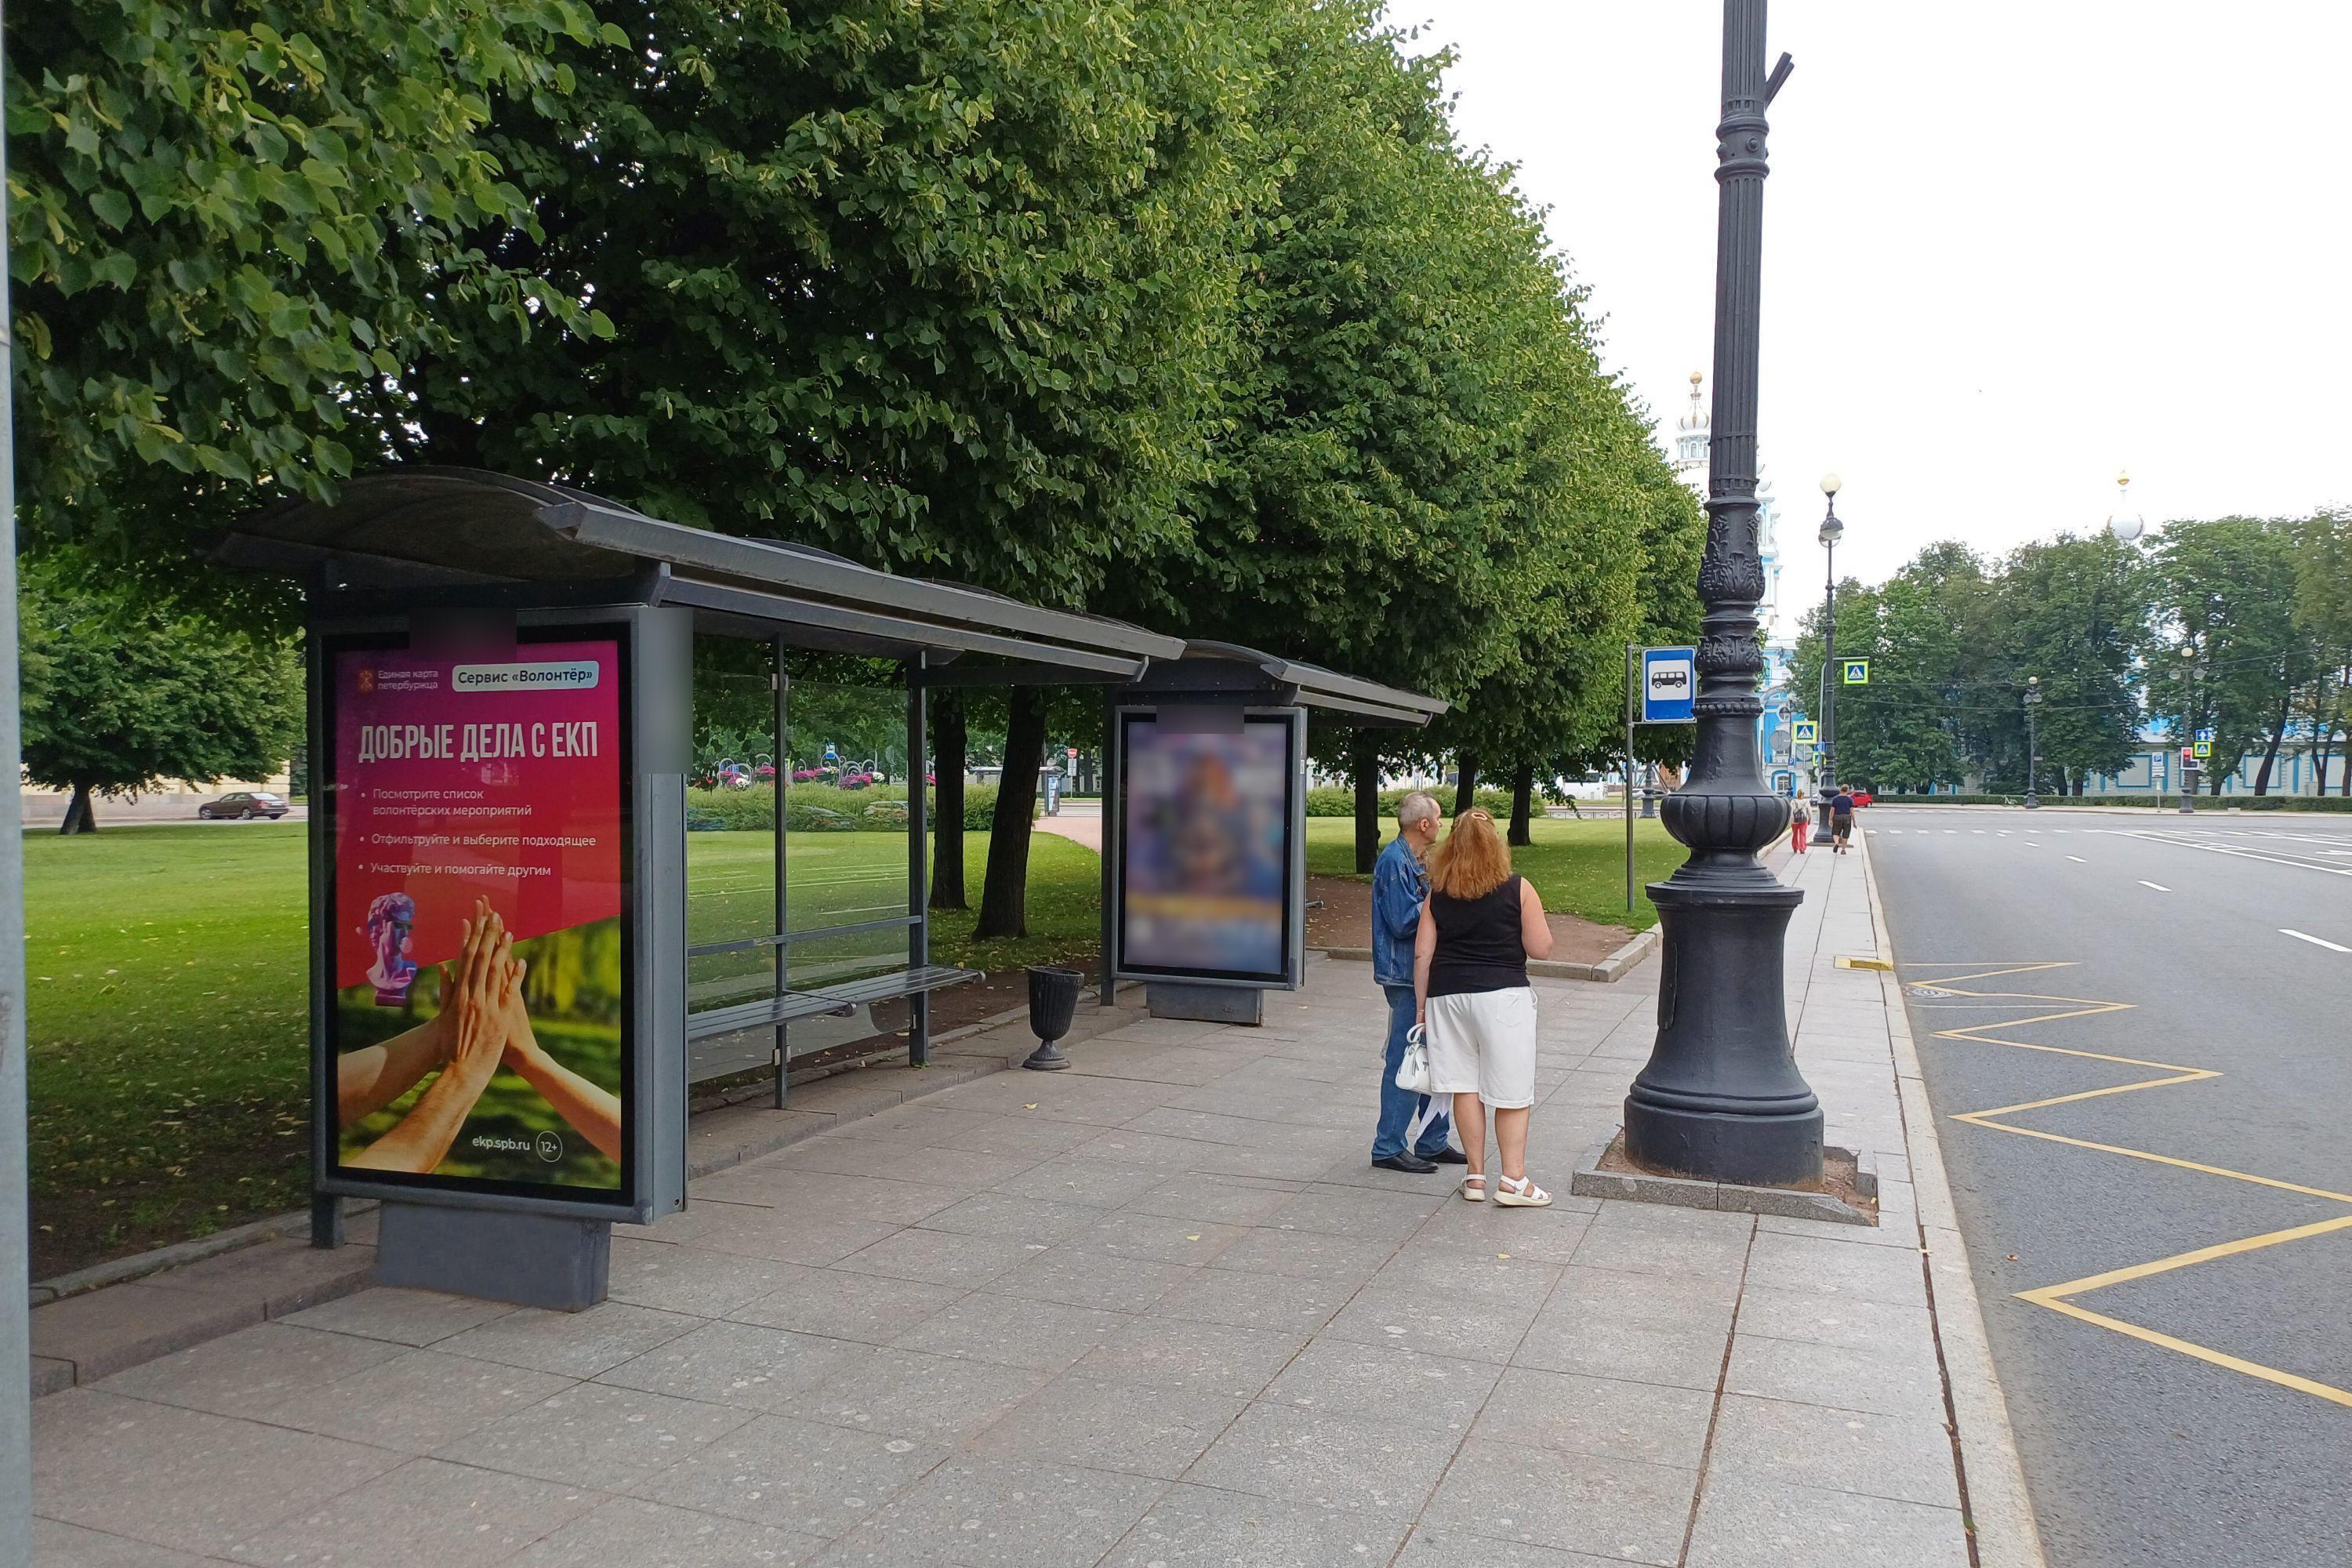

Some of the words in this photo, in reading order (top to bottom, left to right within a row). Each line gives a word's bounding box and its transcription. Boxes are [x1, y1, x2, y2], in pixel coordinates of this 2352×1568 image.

[378, 670, 411, 680] Единая
[413, 670, 438, 679] карта
[458, 672, 508, 686] Сервис
[512, 667, 593, 684] «Волонтёр»
[378, 681, 438, 691] петербуржца
[358, 724, 455, 764] ДОБРЫЕ
[460, 723, 526, 763] ДЕЛА
[531, 722, 546, 758] С
[552, 721, 597, 758] ЕКП
[373, 789, 441, 801] Посмотрите
[443, 789, 484, 800] список
[372, 805, 451, 817] волонтёрских
[453, 804, 532, 818] мероприятий
[372, 833, 450, 846] Отфильтруйте
[452, 836, 460, 844] и
[463, 834, 520, 848] выберите
[522, 836, 597, 848] подходящее
[370, 862, 432, 876] Участвуйте
[434, 866, 441, 874] и
[445, 864, 506, 875] помогайте
[507, 866, 552, 877] другим
[472, 1136, 530, 1151] ekp.spb.ru
[540, 1141, 558, 1152] 12+
